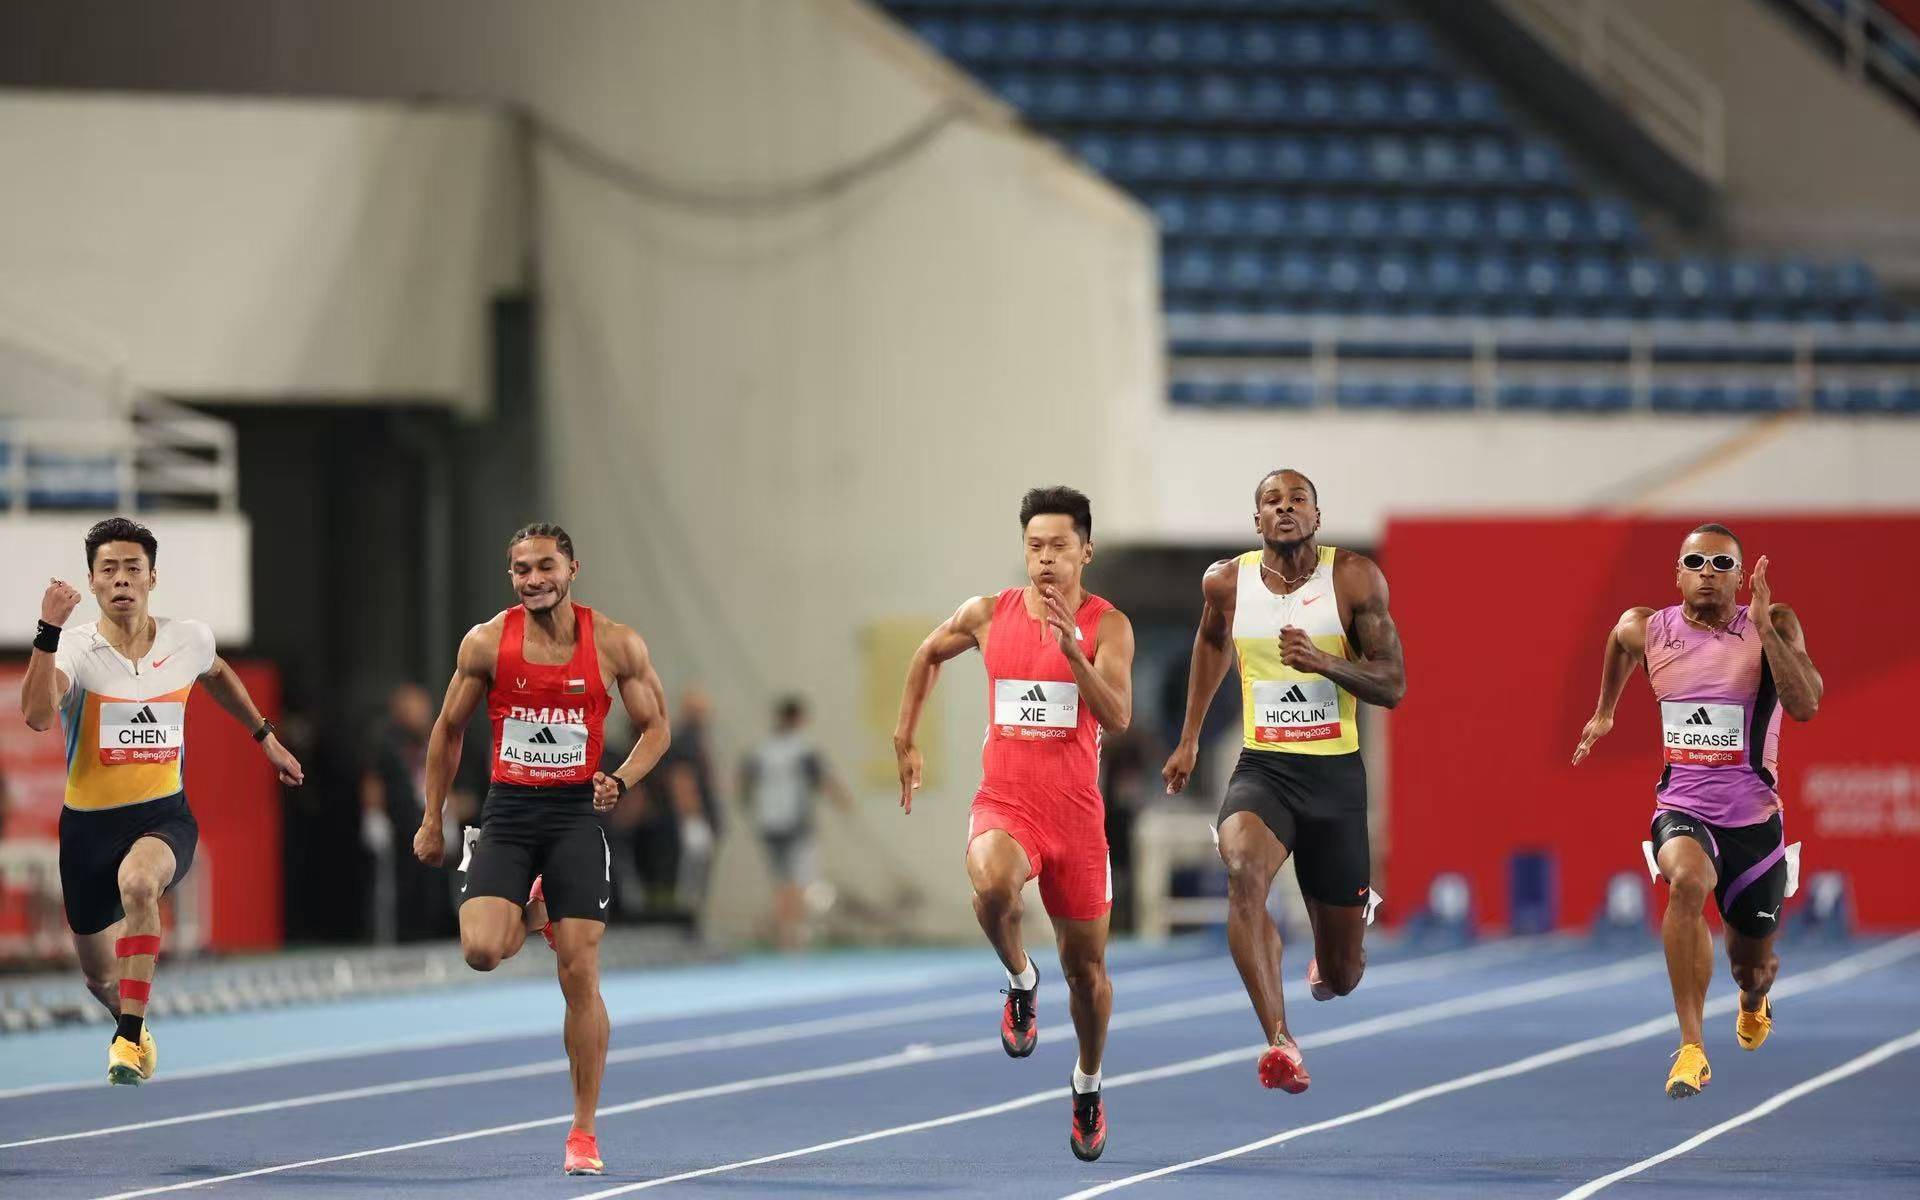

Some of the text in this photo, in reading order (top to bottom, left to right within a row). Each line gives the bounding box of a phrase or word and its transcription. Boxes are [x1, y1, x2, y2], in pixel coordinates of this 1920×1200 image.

[1020, 707, 1046, 722] XIE
[1266, 708, 1326, 723] HICKLIN
[119, 730, 166, 744] CHEN
[1021, 729, 1066, 738] Beijing2025
[1284, 727, 1330, 738] Beijing2025
[1667, 731, 1738, 747] DE GRASSE
[132, 749, 177, 761] Beijing2025
[504, 746, 582, 764] AL BALUSHI
[1688, 752, 1733, 763] Beijing2025
[530, 768, 576, 779] Beijing2025
